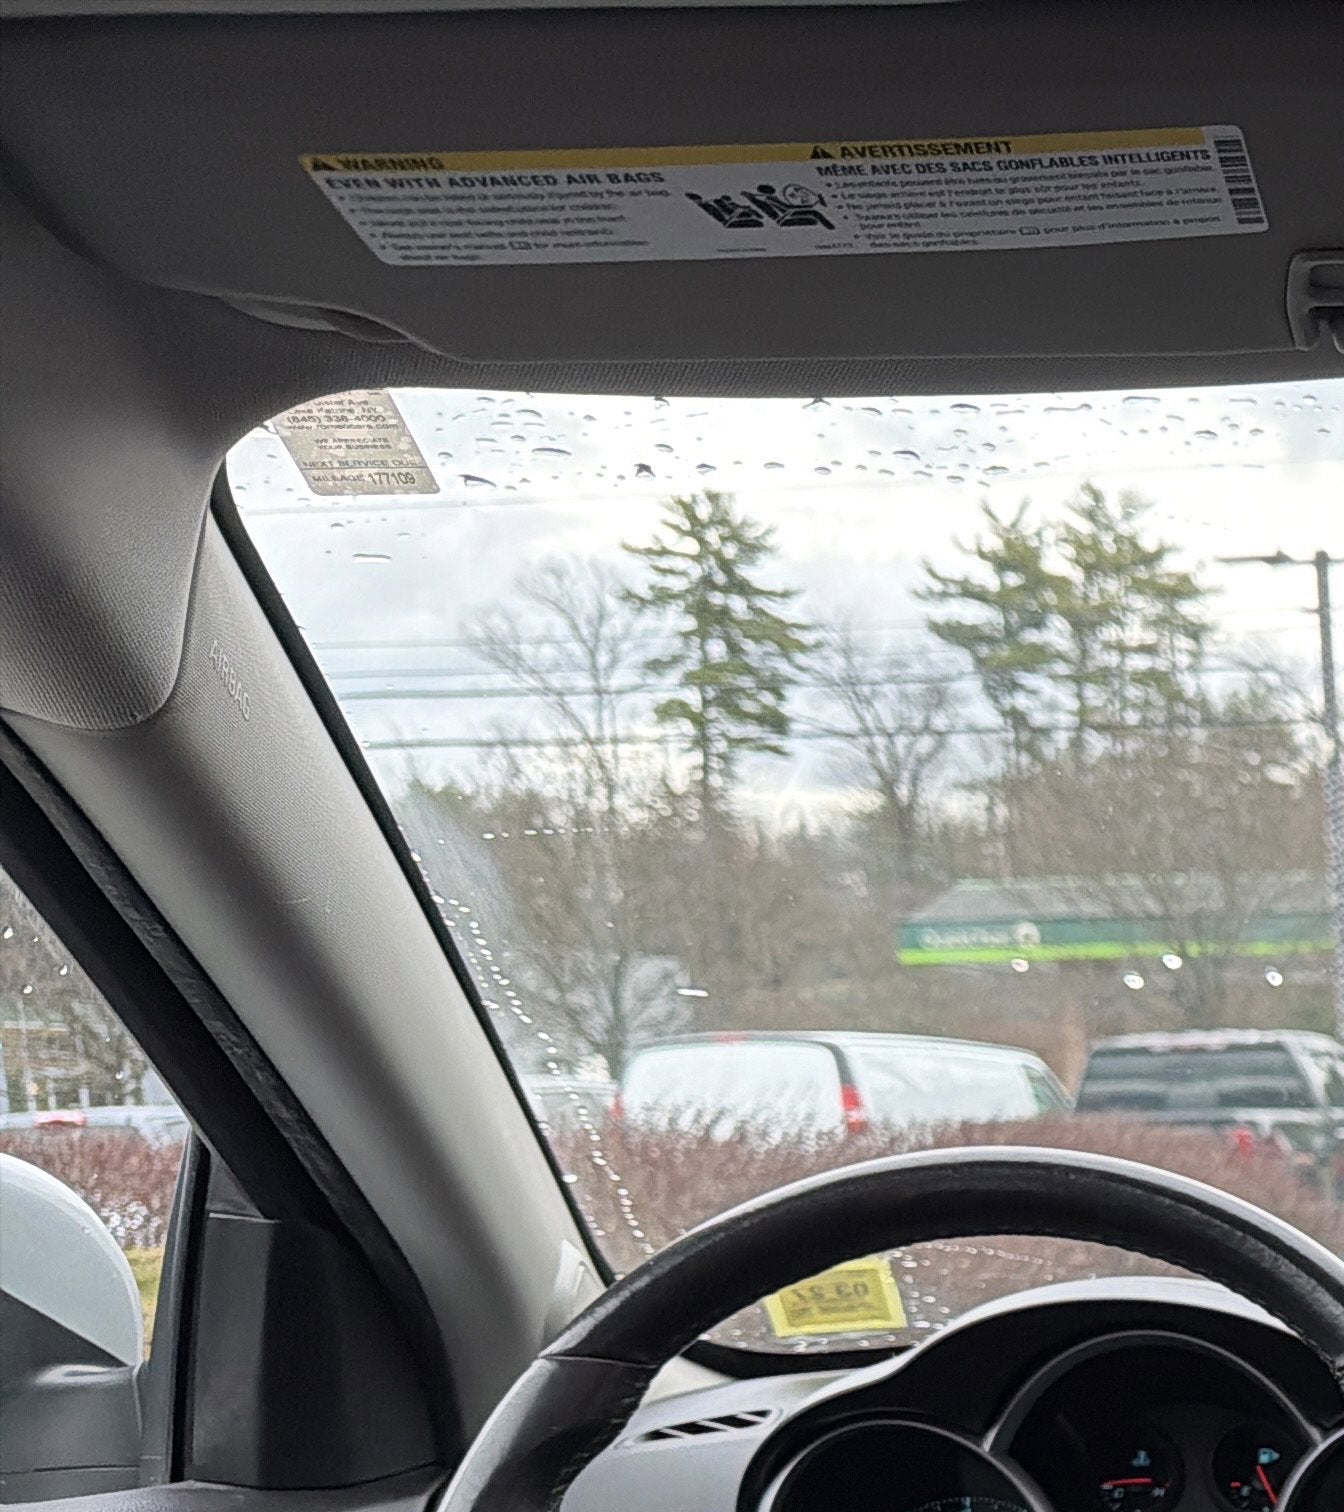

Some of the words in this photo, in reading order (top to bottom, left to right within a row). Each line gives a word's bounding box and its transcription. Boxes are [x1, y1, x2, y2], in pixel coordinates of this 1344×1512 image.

[840, 140, 1013, 160] AVERTISSEMENT
[337, 155, 445, 172] WARNING
[871, 163, 912, 175] AVEC
[914, 162, 947, 174] DES
[949, 160, 993, 173] SACS
[997, 155, 1099, 171] GONFLABLES
[1102, 149, 1211, 165] INTELLIGENTS
[326, 177, 381, 190] EVEN
[384, 177, 441, 189] WITH
[448, 173, 558, 188] ADVANCED
[566, 173, 604, 185] AIR
[606, 171, 665, 184] BAGS
[337, 459, 388, 467] SERVICE
[368, 471, 416, 486] 177109
